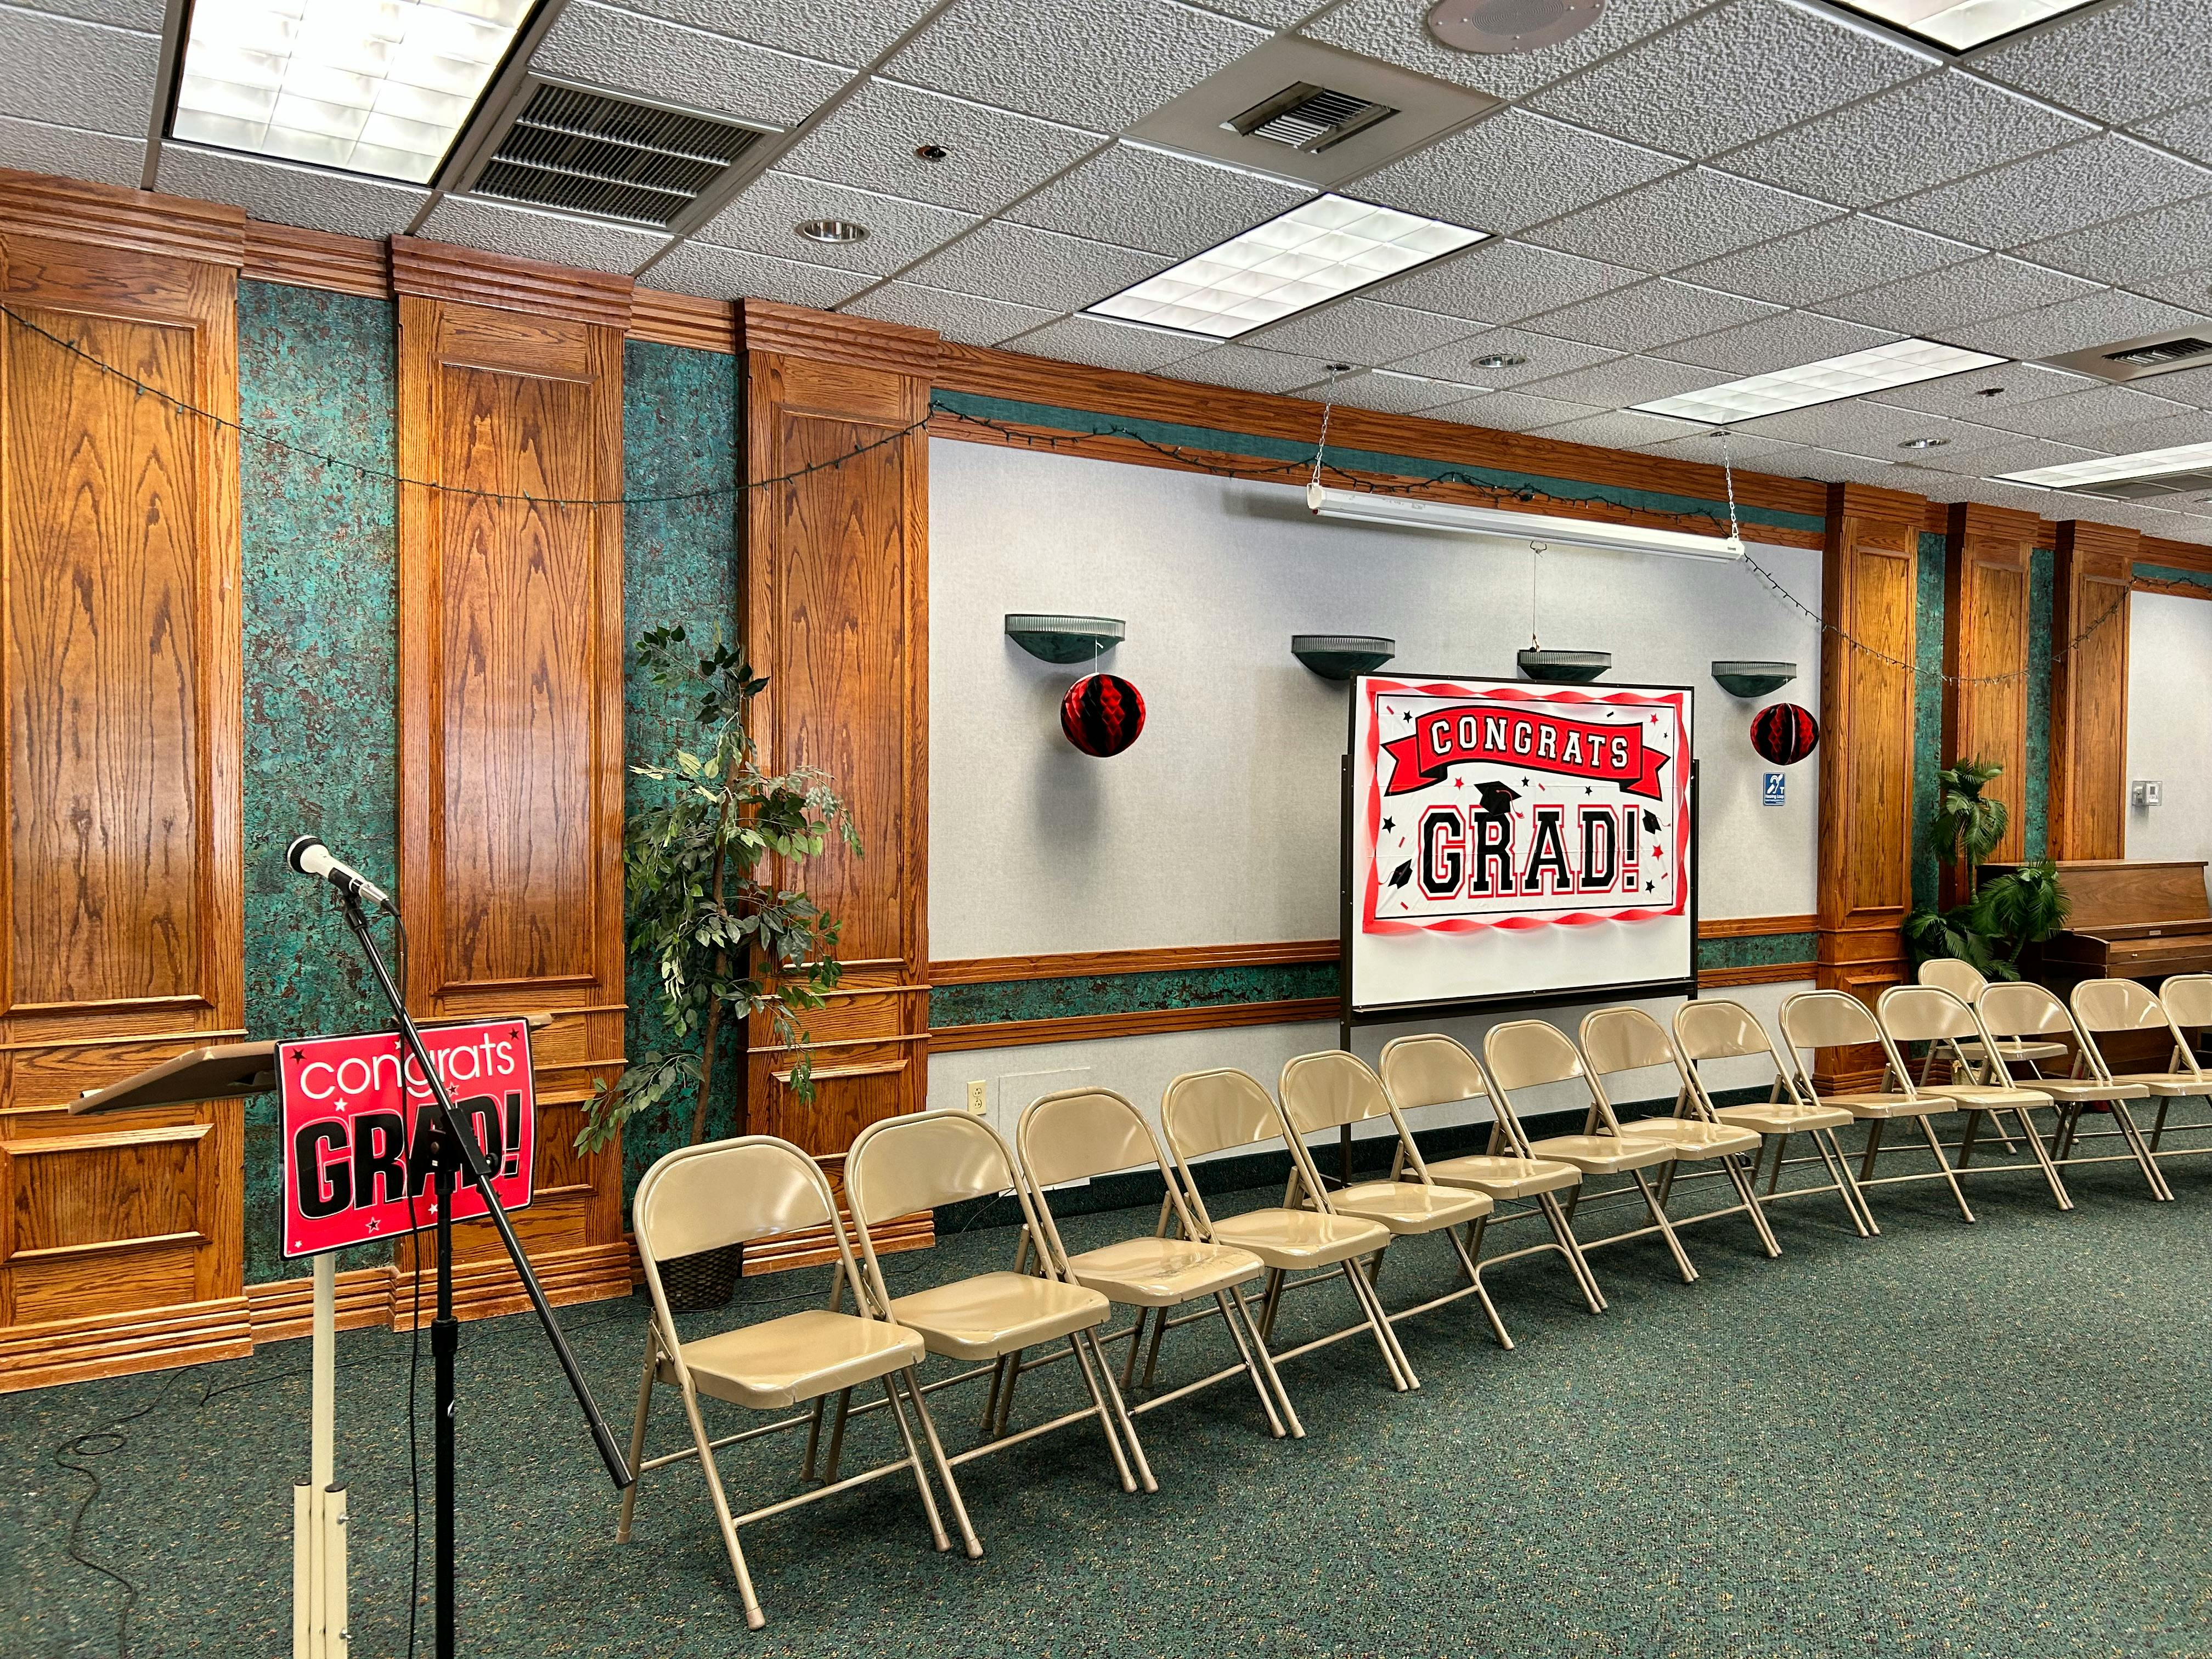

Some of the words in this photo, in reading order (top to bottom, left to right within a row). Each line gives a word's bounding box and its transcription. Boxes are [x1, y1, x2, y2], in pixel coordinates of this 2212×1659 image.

[1431, 716, 1629, 769] CONGRATS
[1418, 804, 1639, 901] GRAD!
[301, 1032, 515, 1099] congrats
